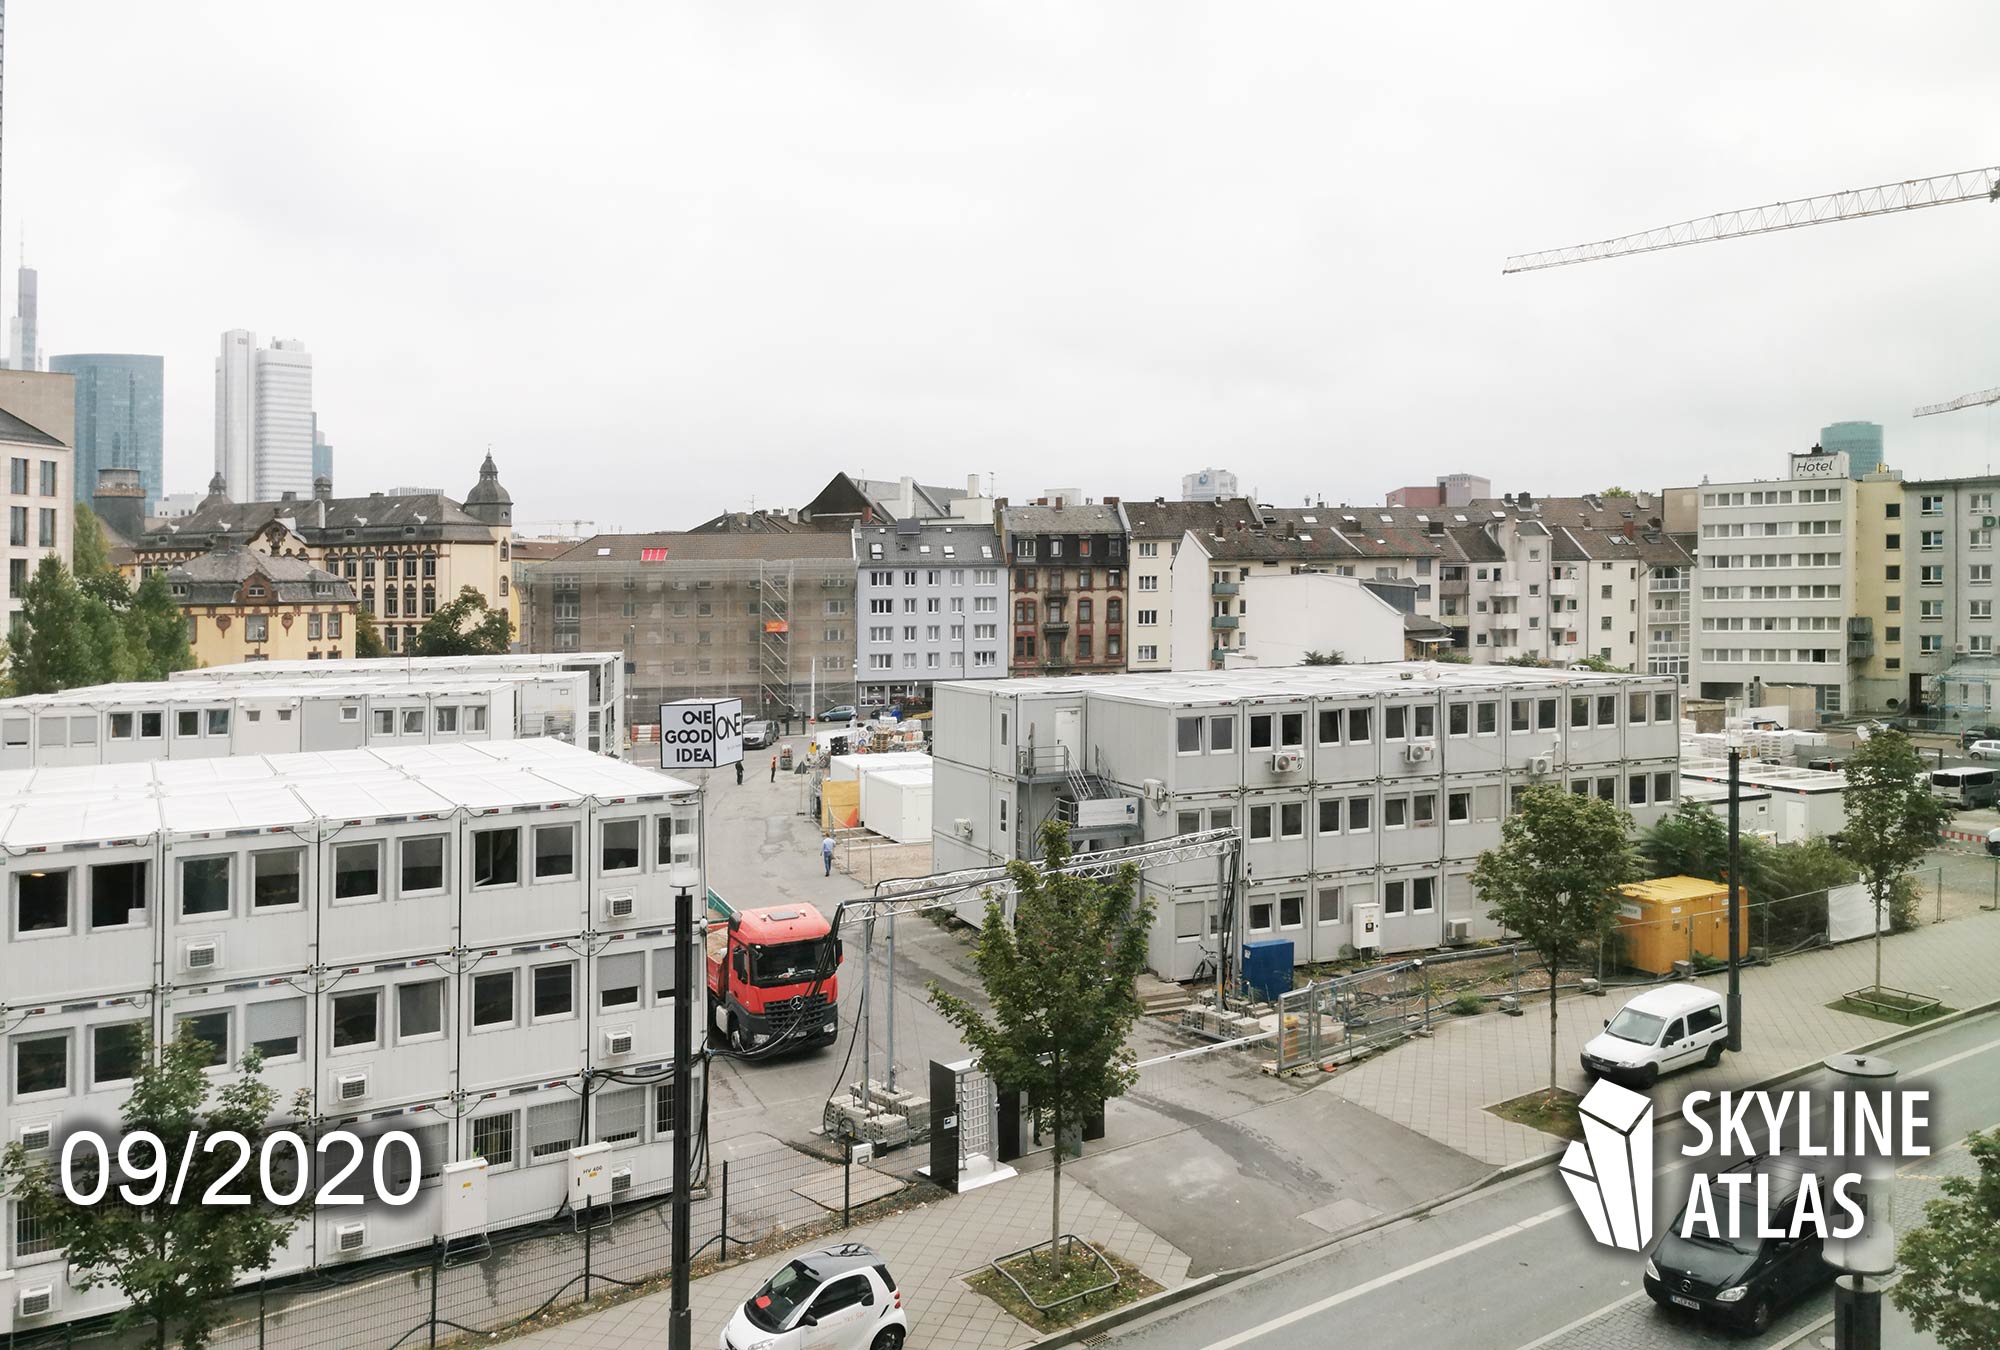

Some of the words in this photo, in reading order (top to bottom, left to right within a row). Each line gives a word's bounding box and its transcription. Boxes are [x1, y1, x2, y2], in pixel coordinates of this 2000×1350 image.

[1796, 460, 1833, 472] Hotel
[1982, 515, 2000, 528] D
[682, 710, 712, 725] ONE
[716, 713, 741, 740] ONE
[664, 729, 713, 744] GOOD
[676, 748, 713, 762] IDEA
